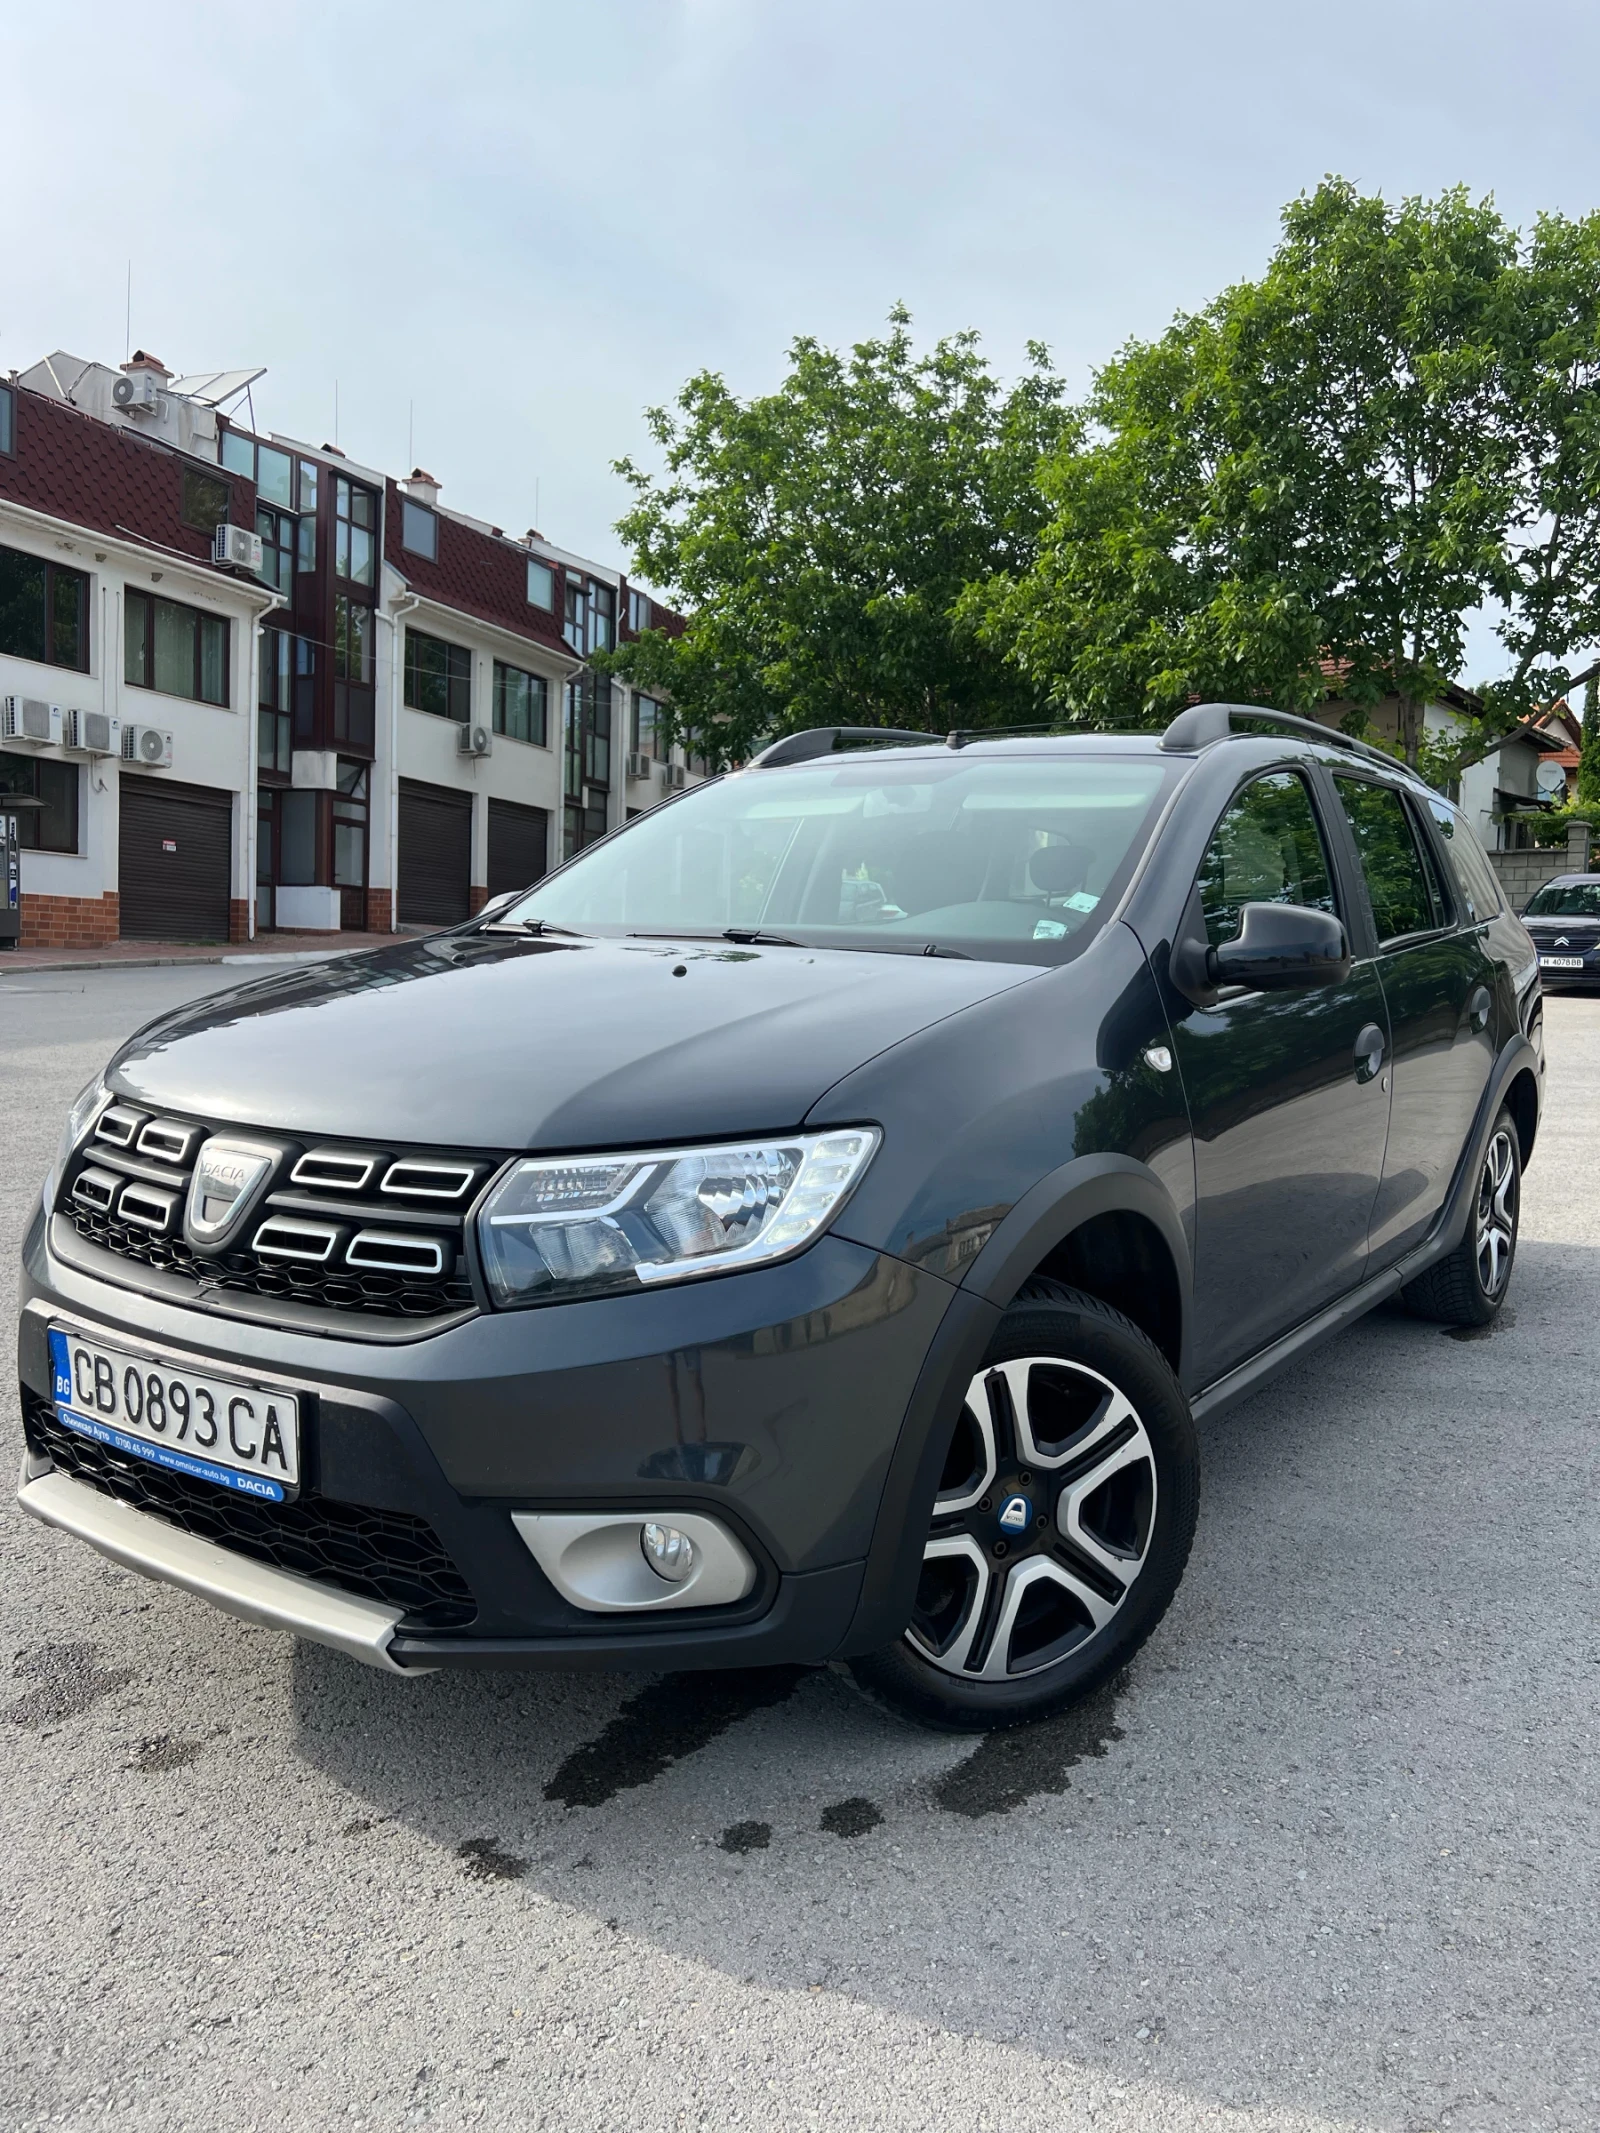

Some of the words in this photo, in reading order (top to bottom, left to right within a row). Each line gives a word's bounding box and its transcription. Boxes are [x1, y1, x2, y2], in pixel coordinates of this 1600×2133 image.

[204, 1163, 245, 1181] DACIA
[56, 1375, 71, 1396] BG
[74, 1347, 117, 1414] CB
[123, 1365, 218, 1447] 0893
[228, 1396, 288, 1471] CA
[115, 1436, 131, 1450] 0700
[132, 1443, 141, 1454] 45
[158, 1453, 230, 1485] www.omnicar-auto.bg
[236, 1477, 276, 1498] DACIA
